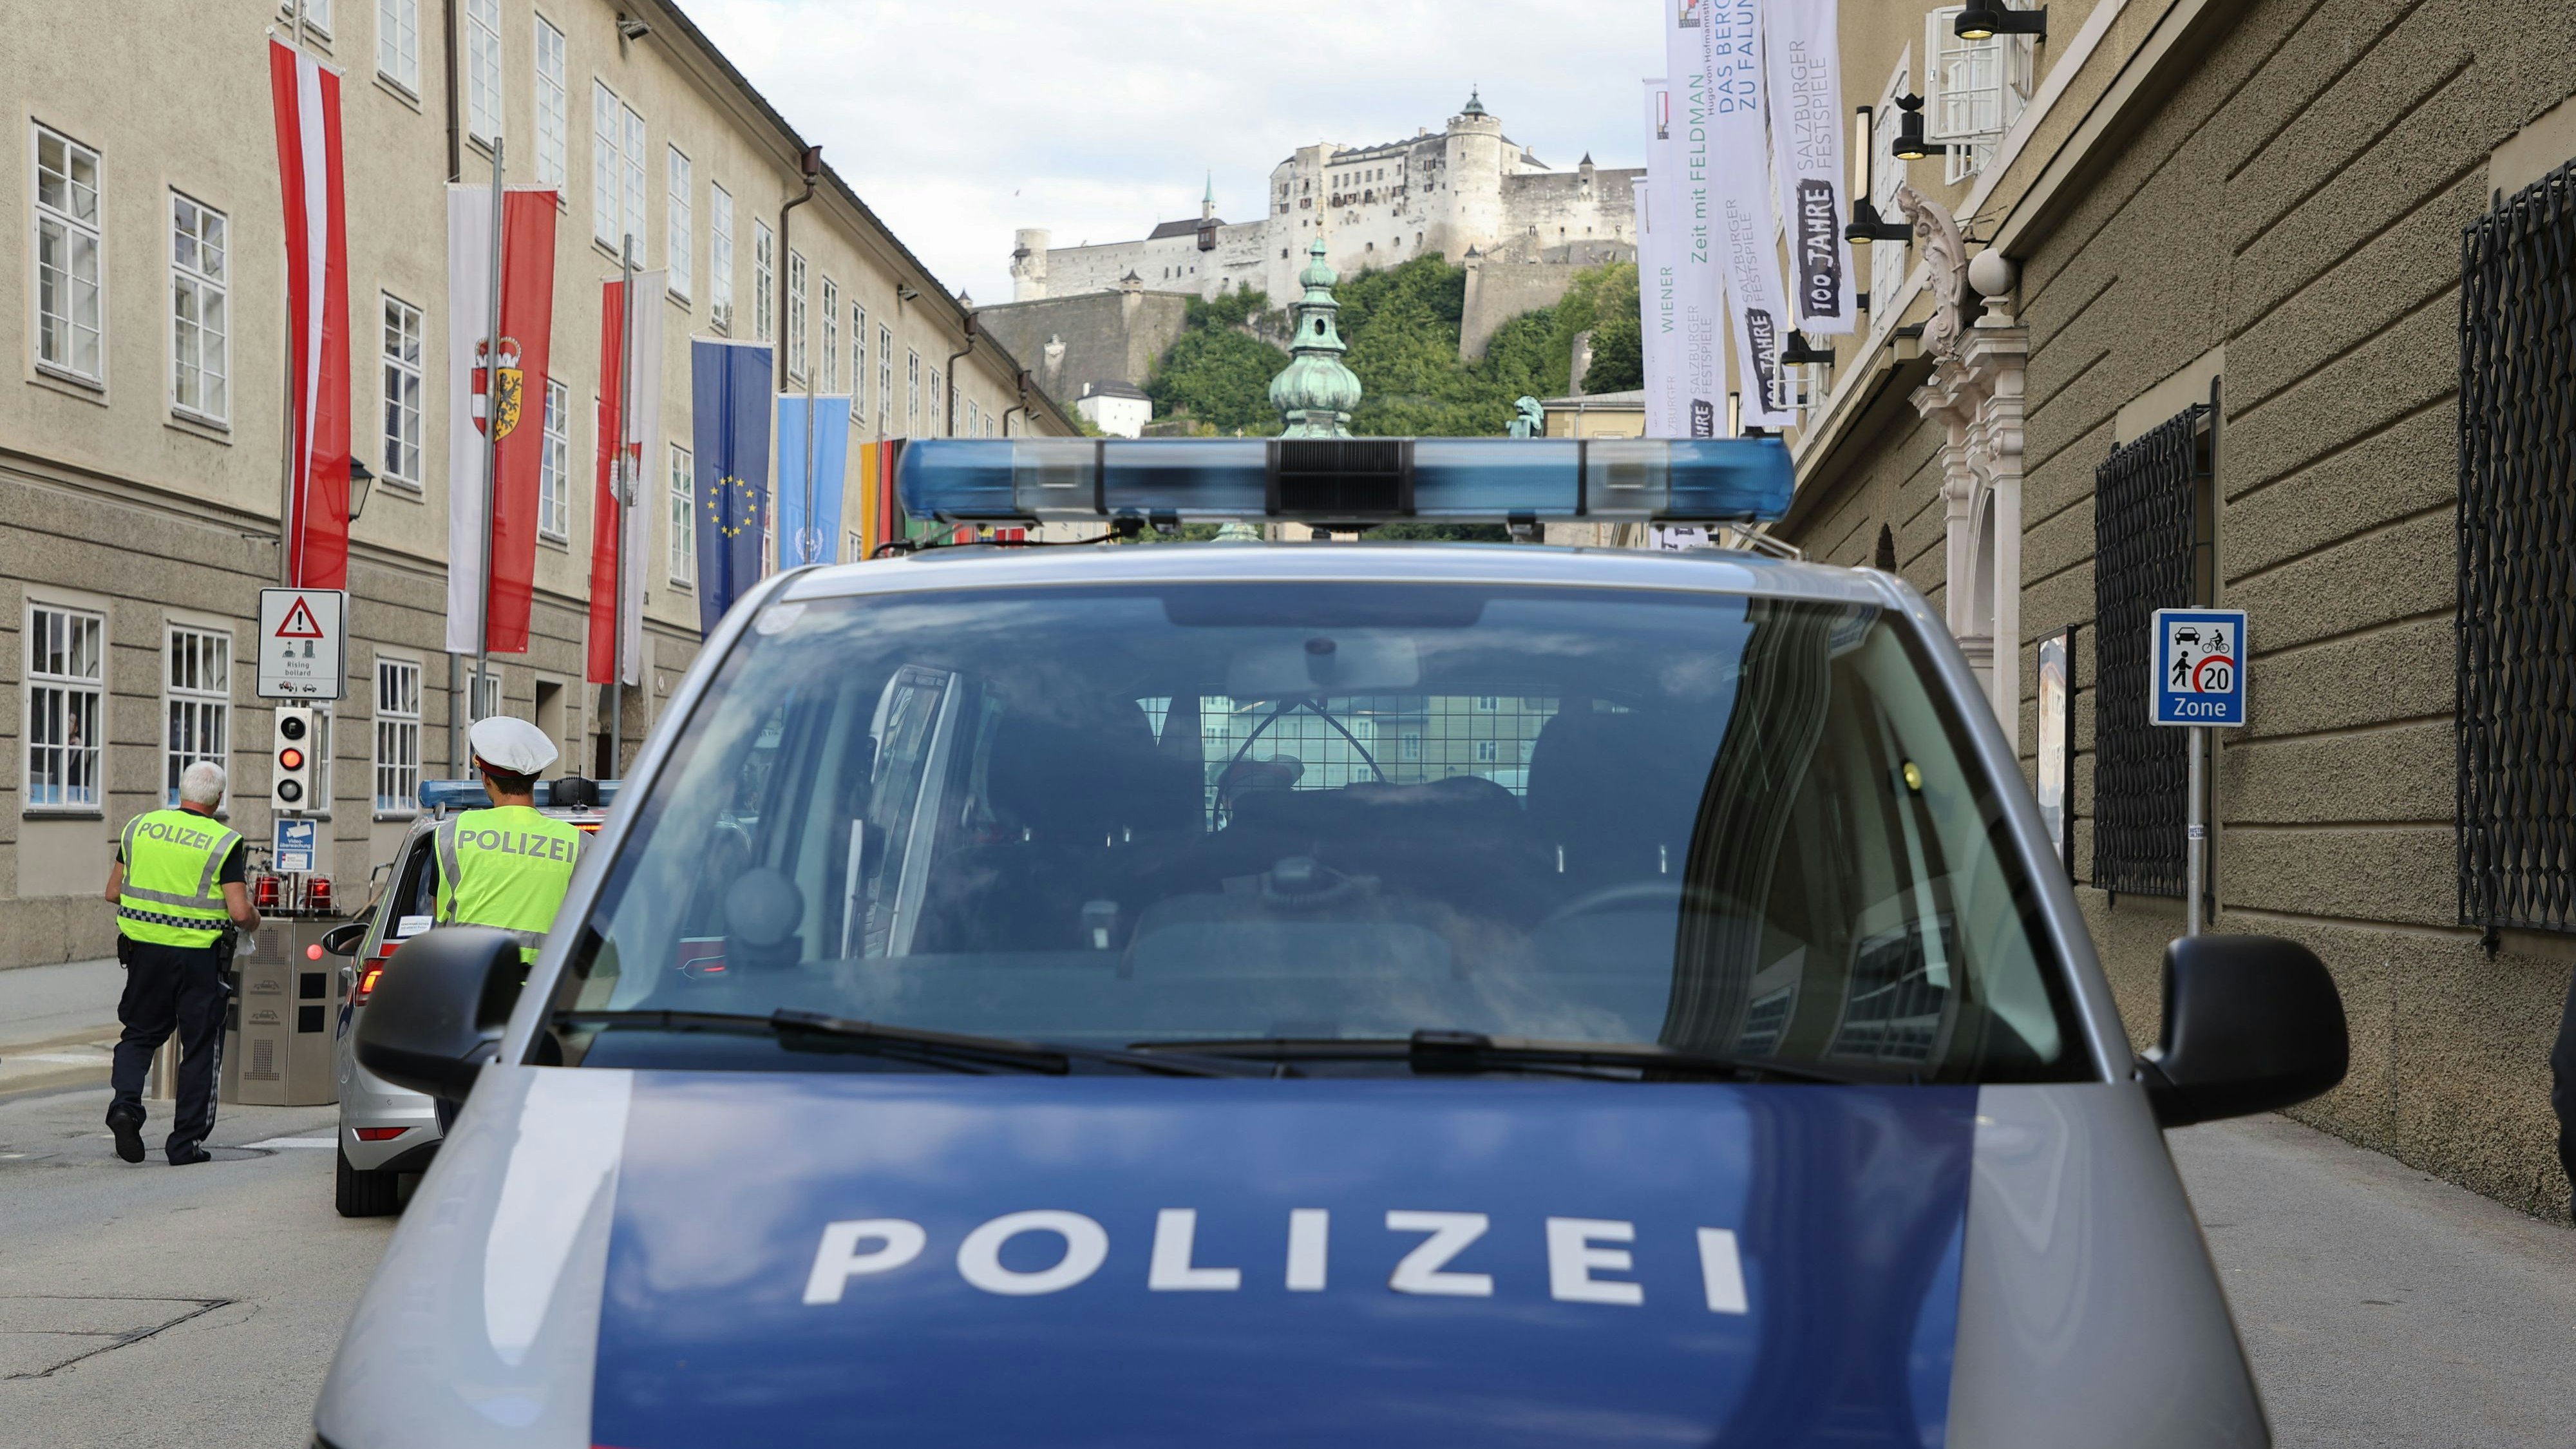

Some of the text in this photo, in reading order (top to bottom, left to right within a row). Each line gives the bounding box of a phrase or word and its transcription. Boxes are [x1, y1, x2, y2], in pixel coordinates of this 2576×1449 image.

[1717, 66, 1734, 113] DAS
[1738, 81, 1756, 110] ZU
[1789, 41, 1814, 171] SALZBURGER
[1809, 57, 1832, 168] FESTSPIELE
[1689, 75, 1707, 263] Zeit mit FELDMAN
[1725, 199, 1753, 303] SALZBURGER
[1739, 212, 1765, 301] FESTSPIELE
[1804, 189, 1834, 310] 100 JAHRE
[1660, 266, 1674, 334] WIENER
[1687, 305, 1701, 395] SALZBURGER
[1701, 317, 1712, 395] FESTSPIELE
[1750, 315, 1775, 375] JAHRE
[1667, 375, 1678, 438] LZBURGER
[1694, 405, 1710, 438] HRE
[287, 661, 309, 669] Rising
[2204, 667, 2229, 690] 20
[2174, 697, 2227, 717] Zone
[137, 822, 214, 851] POLIZEI
[458, 830, 574, 863] POLIZEI
[802, 1208, 1748, 1315] POLIZEI
